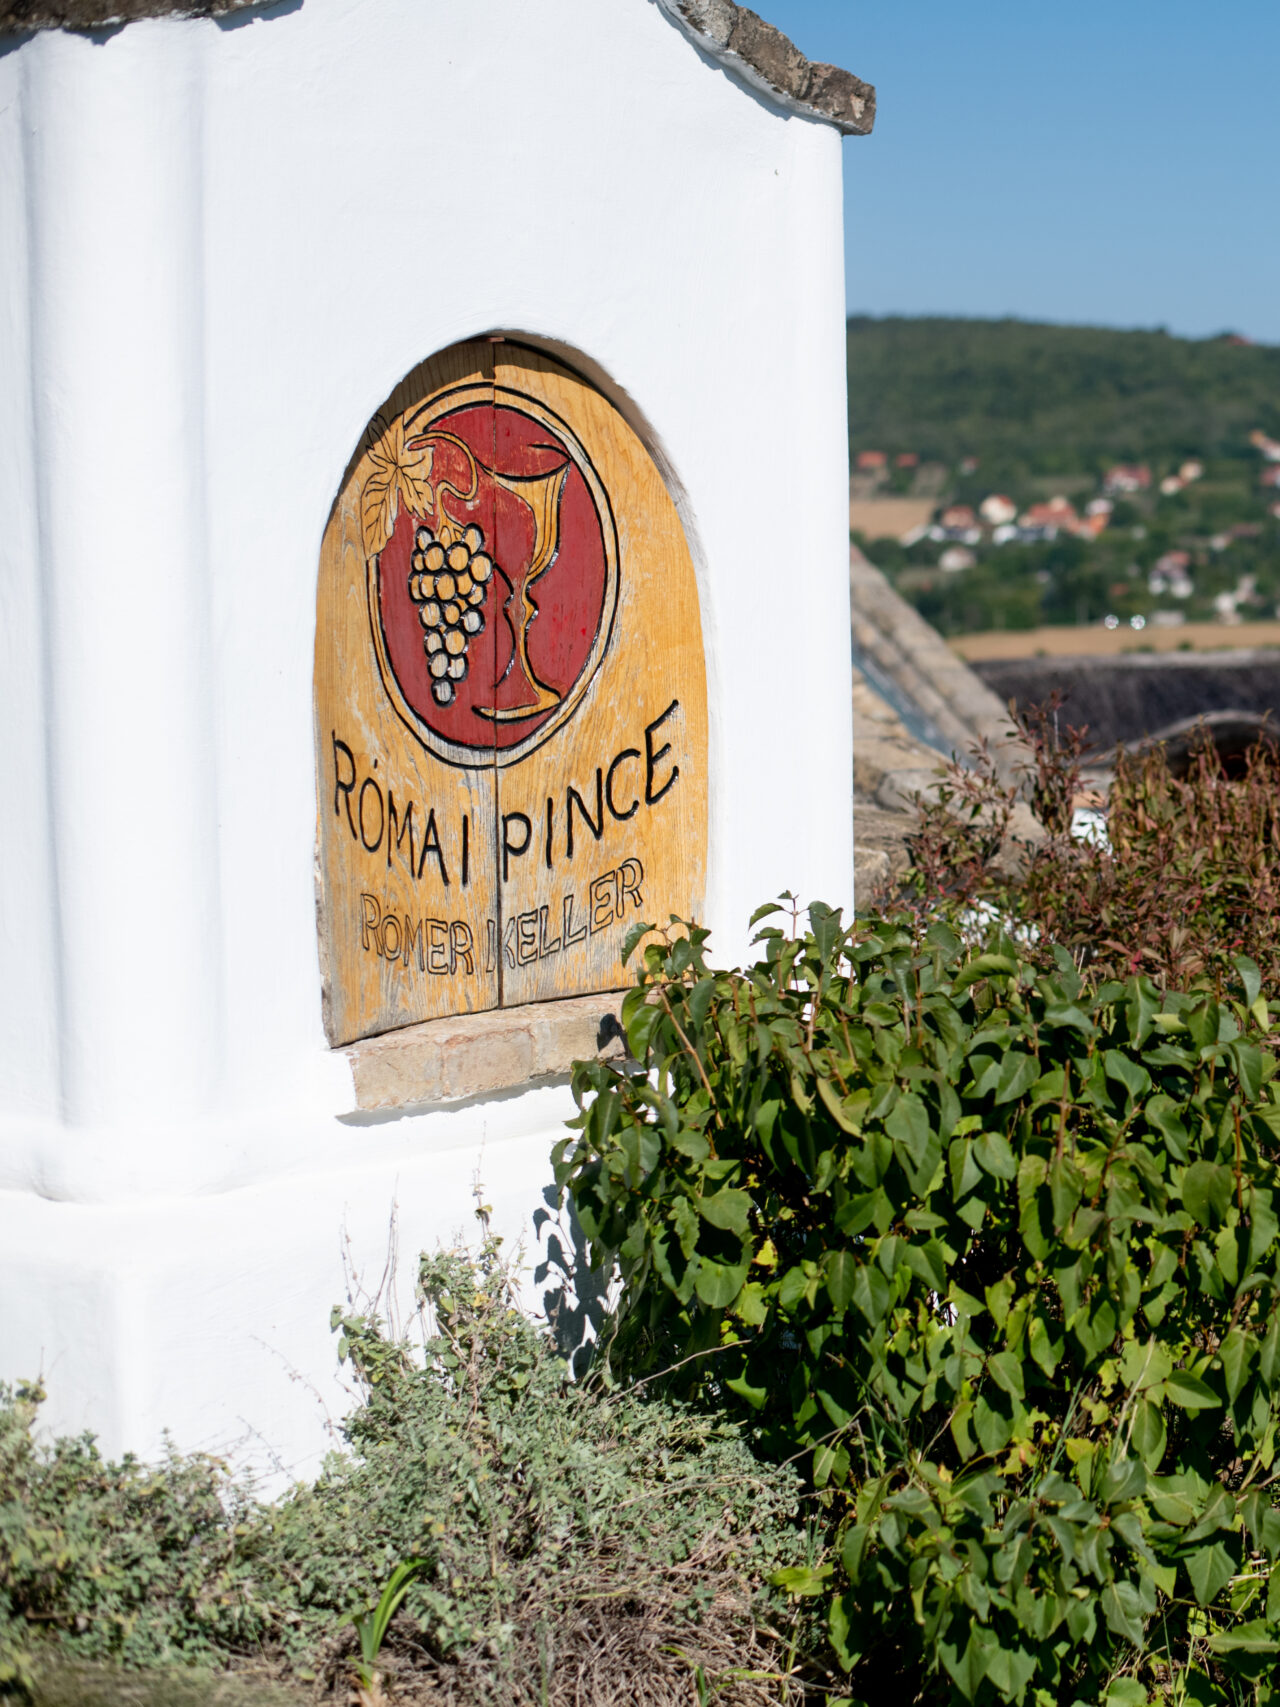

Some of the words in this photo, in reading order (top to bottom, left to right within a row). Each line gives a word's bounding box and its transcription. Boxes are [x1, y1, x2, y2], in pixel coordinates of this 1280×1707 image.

[331, 729, 469, 887] RÓMAI
[501, 698, 680, 883] PINCE
[360, 892, 474, 975] RÖMER
[485, 857, 645, 972] KELLER
